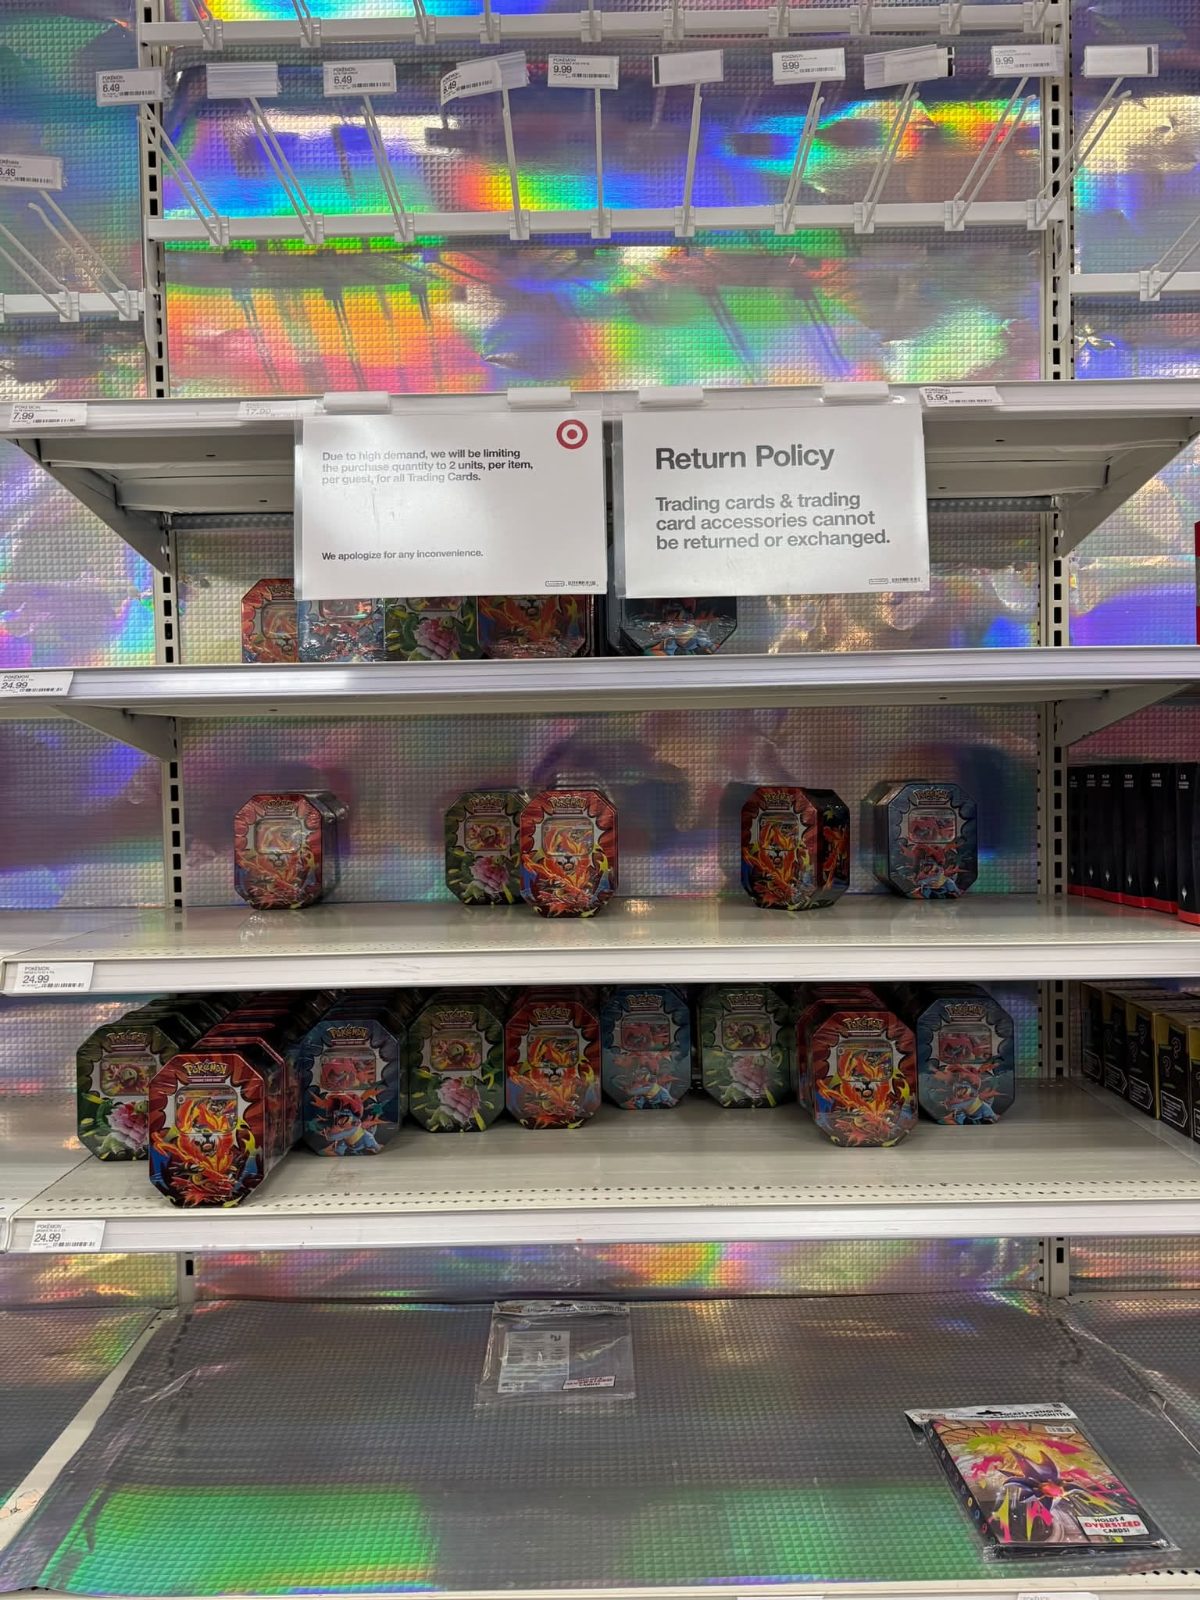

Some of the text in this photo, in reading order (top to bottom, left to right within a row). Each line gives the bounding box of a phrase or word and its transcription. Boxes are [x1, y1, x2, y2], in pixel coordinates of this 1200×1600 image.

[995, 56, 1014, 65] 9.99
[553, 65, 572, 73] 9.99
[782, 62, 800, 70] 9.99
[334, 76, 352, 84] 6.49
[102, 84, 120, 92] 6.49
[13, 412, 34, 420] 7.99
[322, 448, 521, 464] Due to high demand, we will be limiting
[656, 444, 835, 470] Return Policy
[322, 460, 533, 474] the purchase quantity to 2 units, per item,
[322, 472, 481, 486] per guest, for all Trading Cards.
[656, 492, 861, 513] Trading cards & trading
[656, 510, 876, 531] card accessories cannot
[656, 530, 890, 550] be returned or exchanged.
[322, 548, 484, 562] We apologize for any inconvenience.
[1, 682, 28, 690] 24.99
[22, 975, 50, 984] 24.99
[34, 1232, 60, 1242] 24.99
